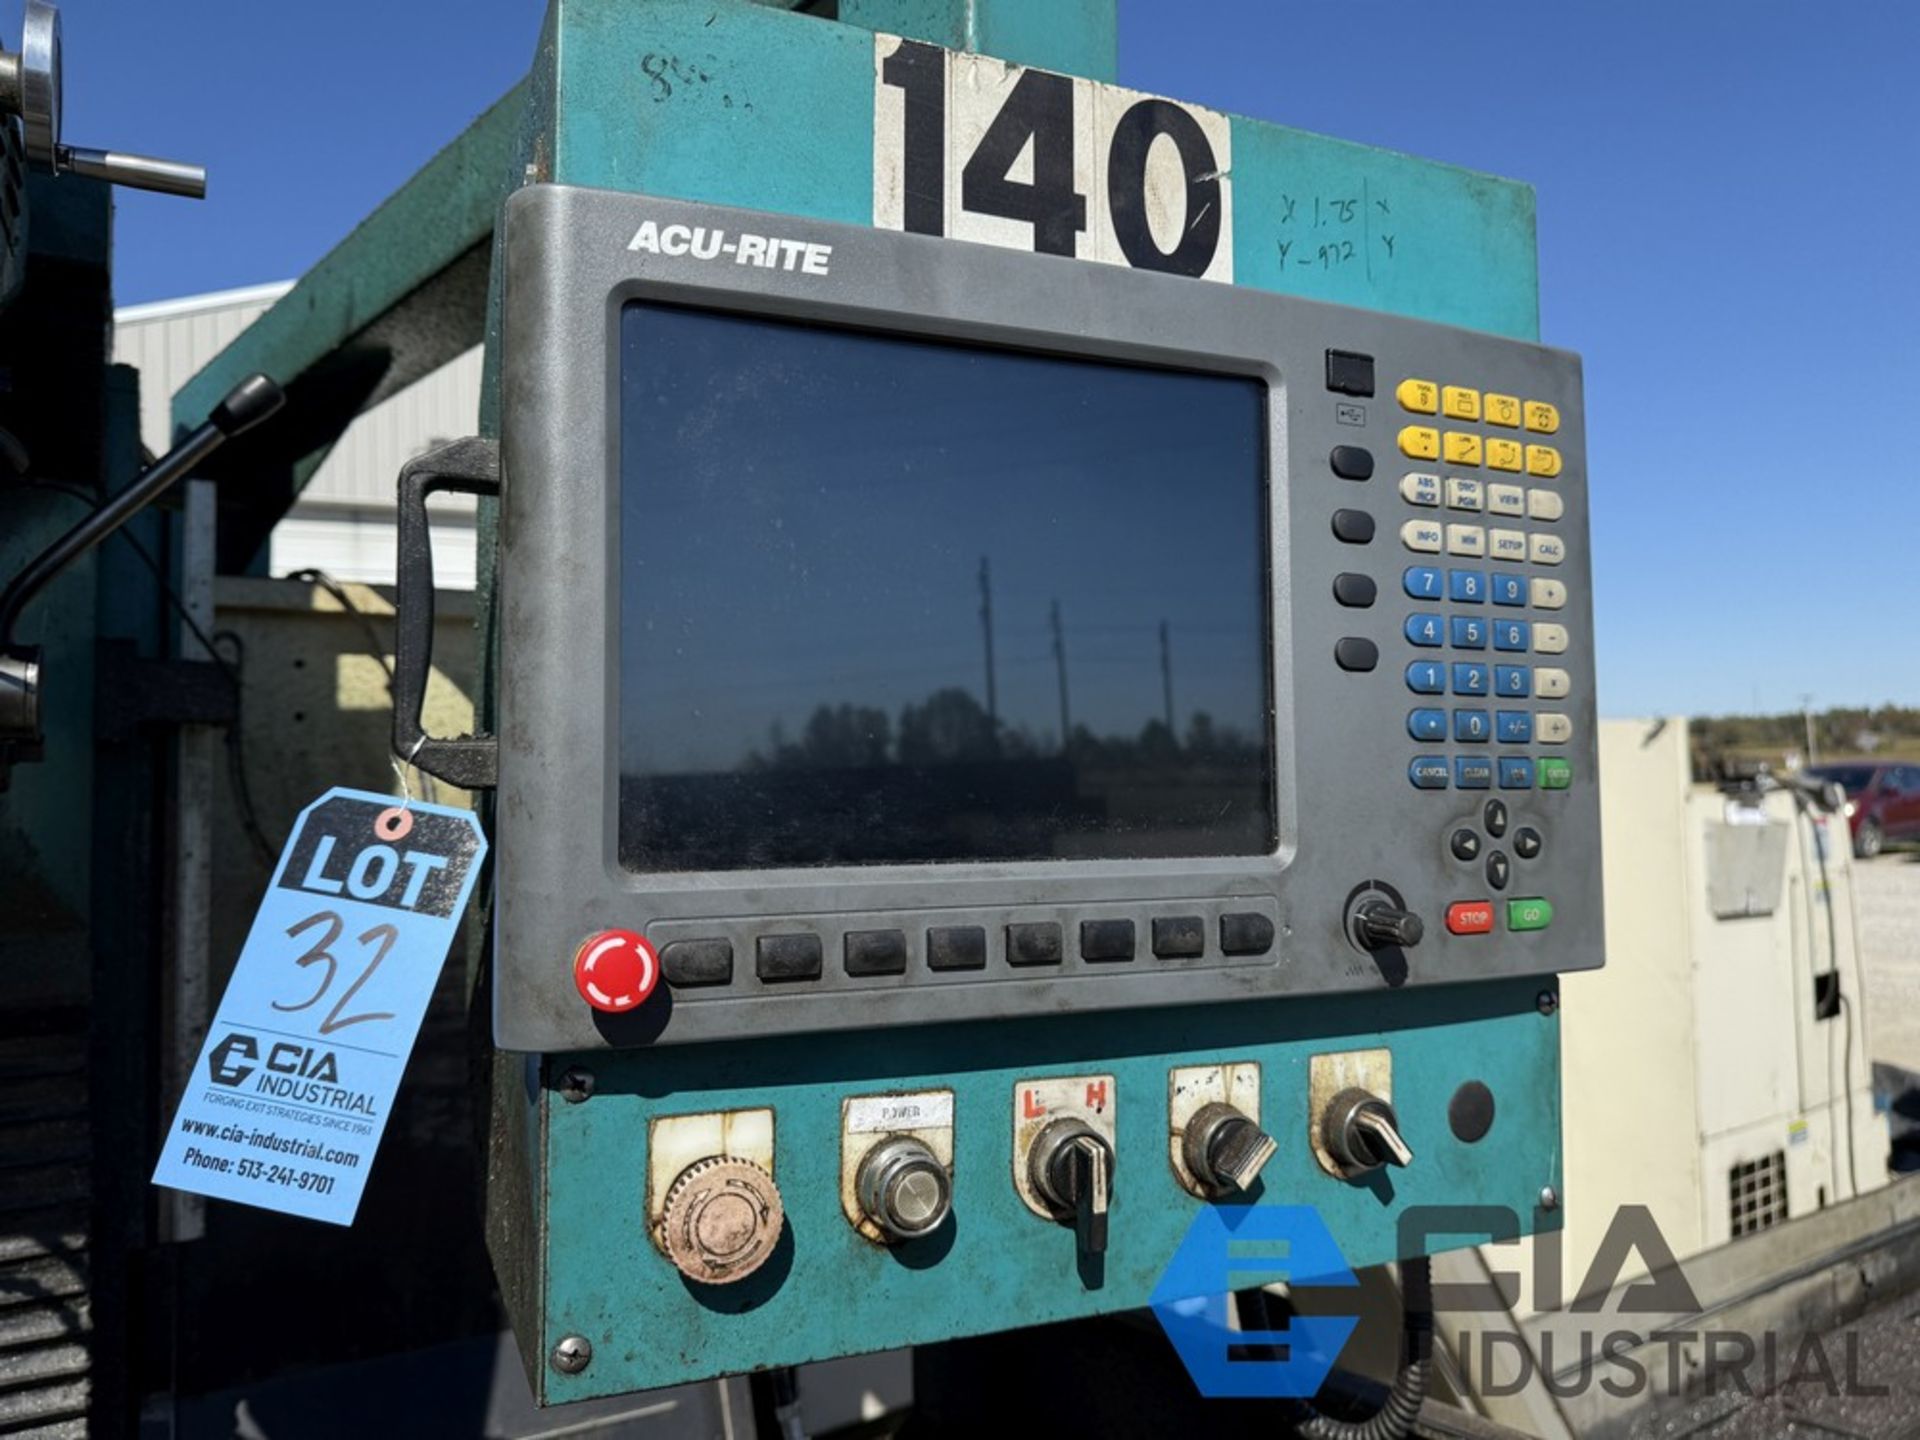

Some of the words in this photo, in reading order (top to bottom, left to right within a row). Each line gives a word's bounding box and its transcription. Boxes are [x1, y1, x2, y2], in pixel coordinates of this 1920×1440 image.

[883, 38, 1222, 279] 140
[627, 220, 832, 276] ACU-RITE
[1417, 477, 1435, 489] ABS
[1499, 494, 1520, 505] VIEW
[1417, 530, 1439, 542] INFO
[1498, 539, 1523, 550] SETUP
[1539, 544, 1559, 555] CALC
[1423, 573, 1434, 591] 7
[1466, 577, 1476, 595] 8
[1507, 581, 1518, 598] 9
[1424, 621, 1435, 638] 4
[1467, 623, 1478, 641] 5
[1509, 626, 1520, 644] 6
[1426, 668, 1435, 686] 1
[1468, 670, 1479, 688] 2
[1511, 672, 1521, 690] 3
[1470, 716, 1481, 734] 0
[1415, 767, 1449, 777] CANCEL
[301, 835, 449, 909] LOT
[1459, 911, 1488, 925] STOP
[1524, 908, 1540, 921] GO
[271, 909, 399, 1035] 32
[265, 1041, 338, 1084] CIA
[256, 1074, 378, 1116] INDUSTRIAL
[1024, 1088, 1046, 1119] L
[1086, 1080, 1106, 1111] H
[203, 1092, 244, 1111] FORGING
[244, 1099, 266, 1113] EXIT
[266, 1103, 321, 1126] STRATEGIES
[322, 1115, 350, 1132] SINCE
[882, 1105, 921, 1119] POWER
[181, 1117, 360, 1168] www.cia-industrial.com
[182, 1147, 235, 1174] Phone:
[237, 1158, 335, 1195] 513-241-9701
